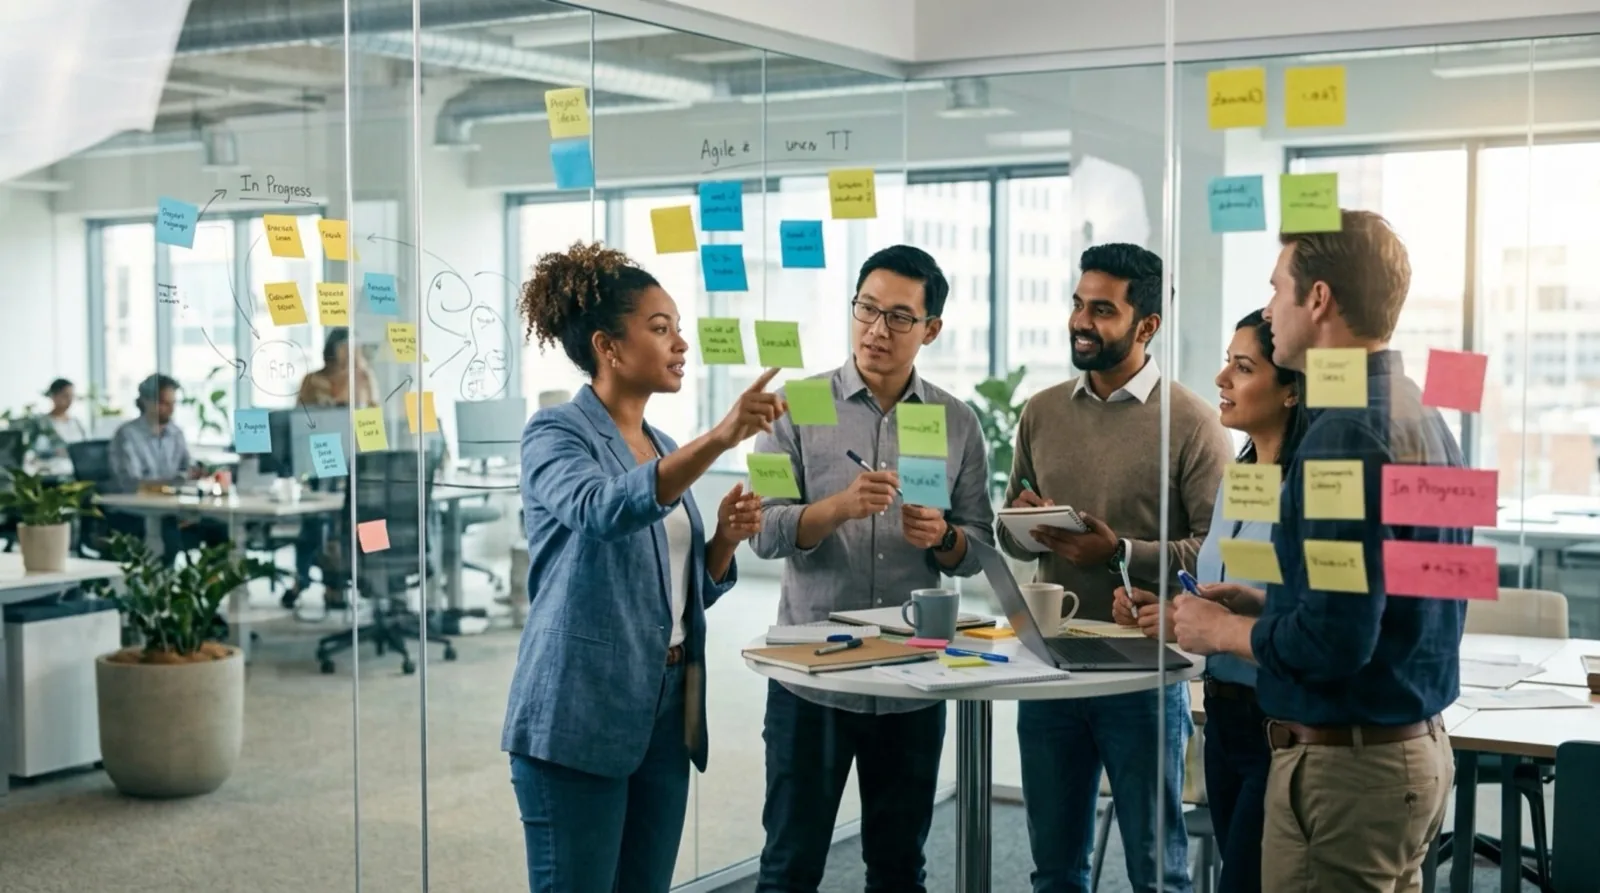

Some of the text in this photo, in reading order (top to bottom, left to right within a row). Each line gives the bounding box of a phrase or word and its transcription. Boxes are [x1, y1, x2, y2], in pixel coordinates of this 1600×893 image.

[700, 138, 736, 167] Agile
[240, 174, 312, 204] In Progress
[1390, 478, 1410, 497] In
